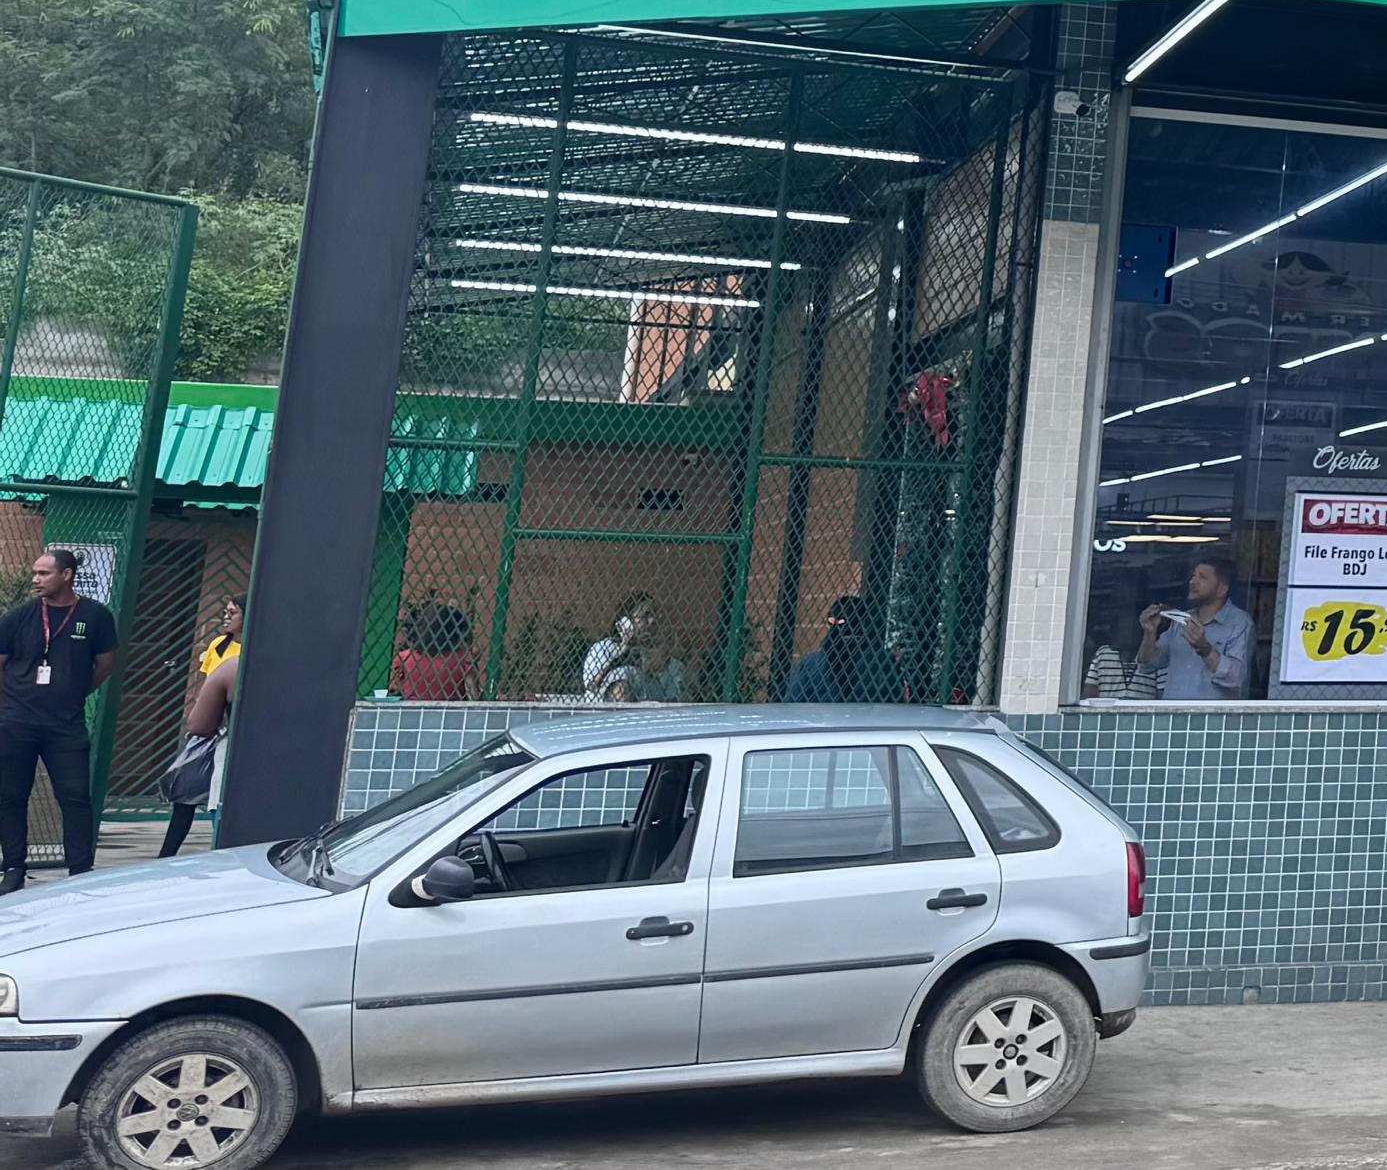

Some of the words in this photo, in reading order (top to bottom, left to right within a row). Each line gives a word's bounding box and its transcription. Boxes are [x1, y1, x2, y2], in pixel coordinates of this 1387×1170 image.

[1312, 445, 1381, 474] Ofertas
[1304, 545, 1327, 559] File
[1331, 547, 1375, 563] Frango
[1343, 563, 1367, 576] BDJ
[1301, 620, 1318, 632] R$
